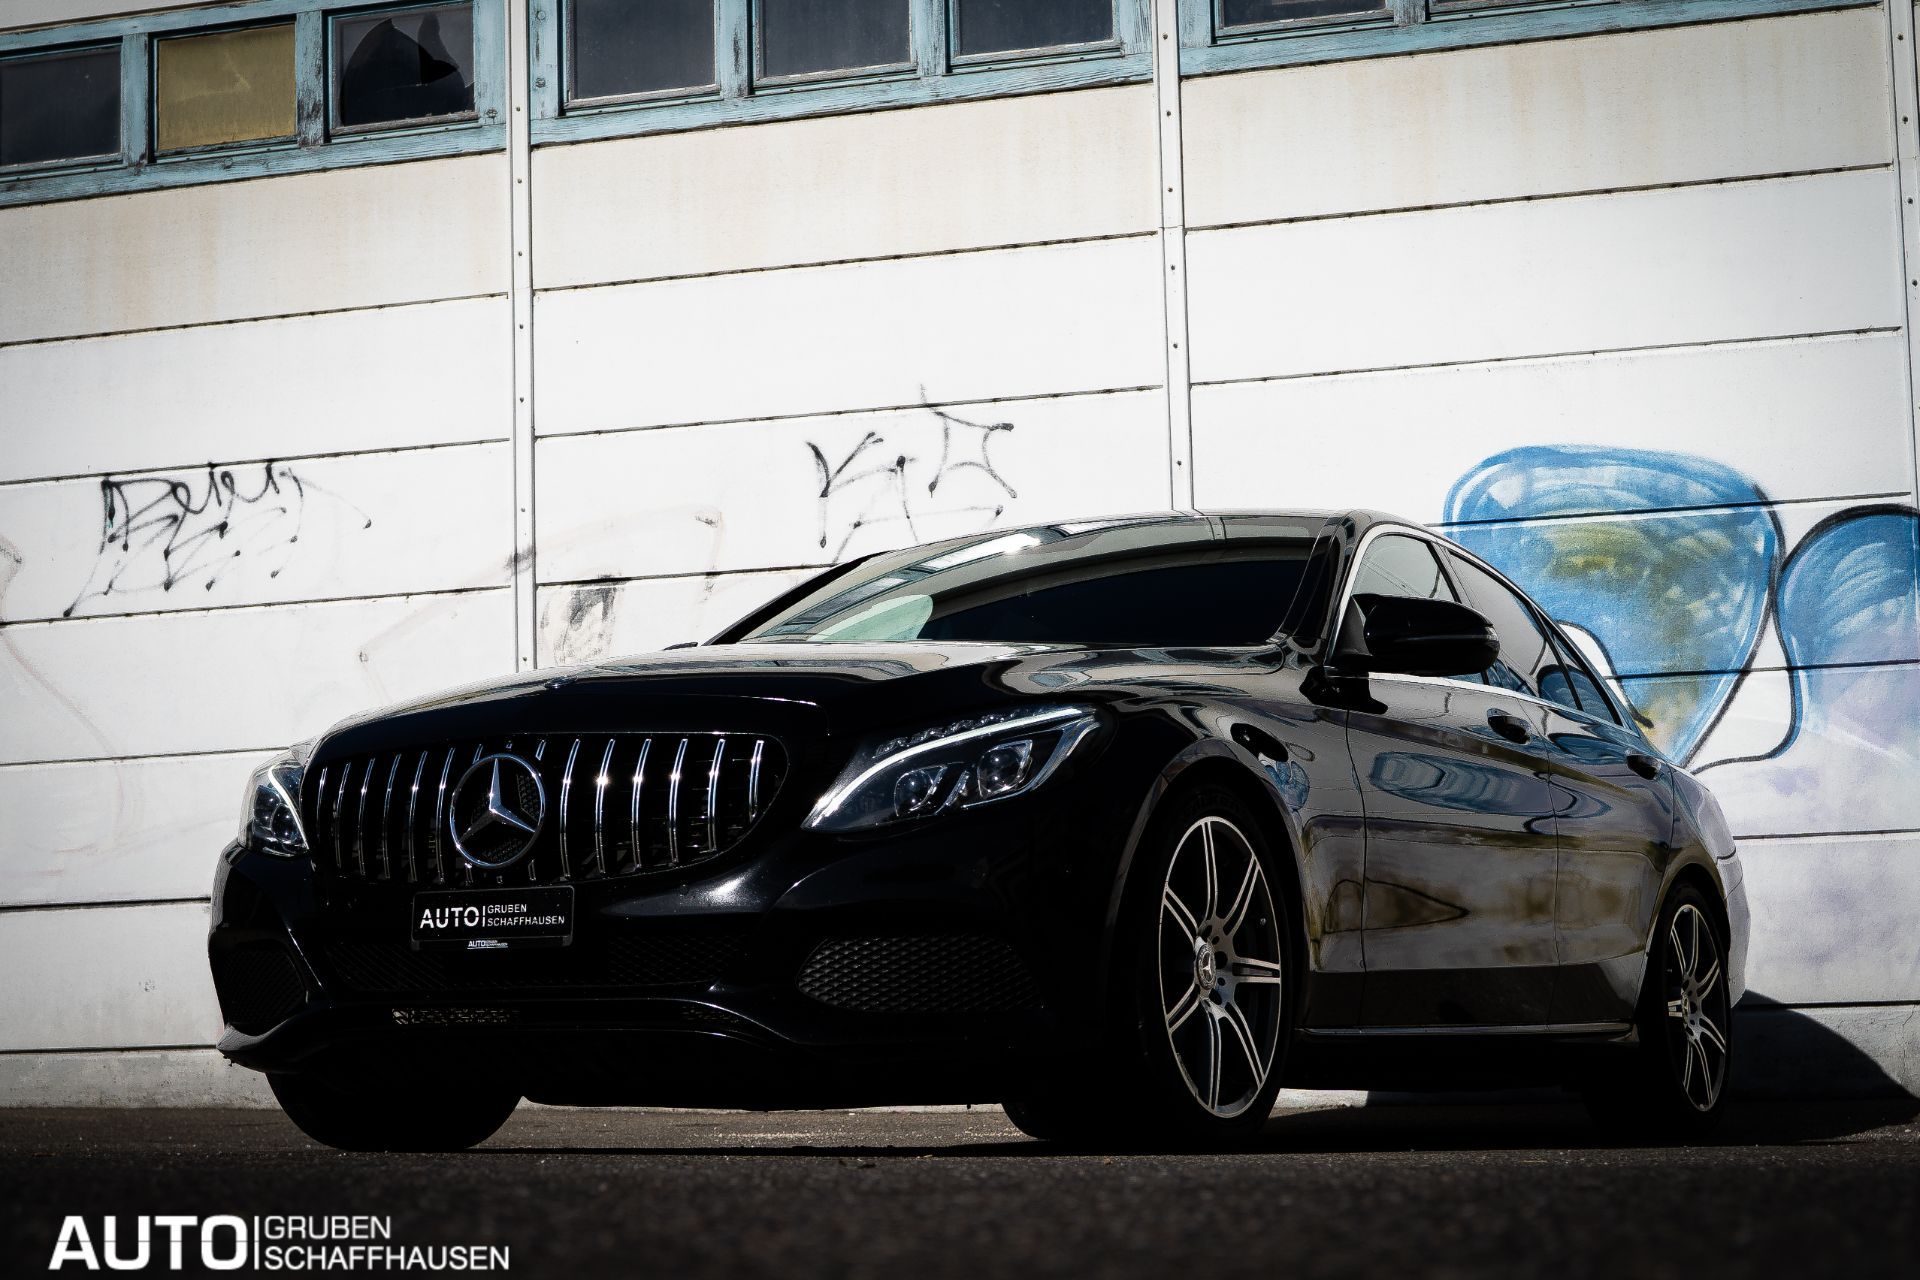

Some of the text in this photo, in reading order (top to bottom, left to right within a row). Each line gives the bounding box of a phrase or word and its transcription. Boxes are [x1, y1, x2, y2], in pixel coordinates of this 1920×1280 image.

[487, 903, 528, 914] GRUBEN
[419, 906, 480, 929] AUTO
[487, 915, 566, 927] SCHAFFHAUSEN
[468, 940, 486, 948] AUTO
